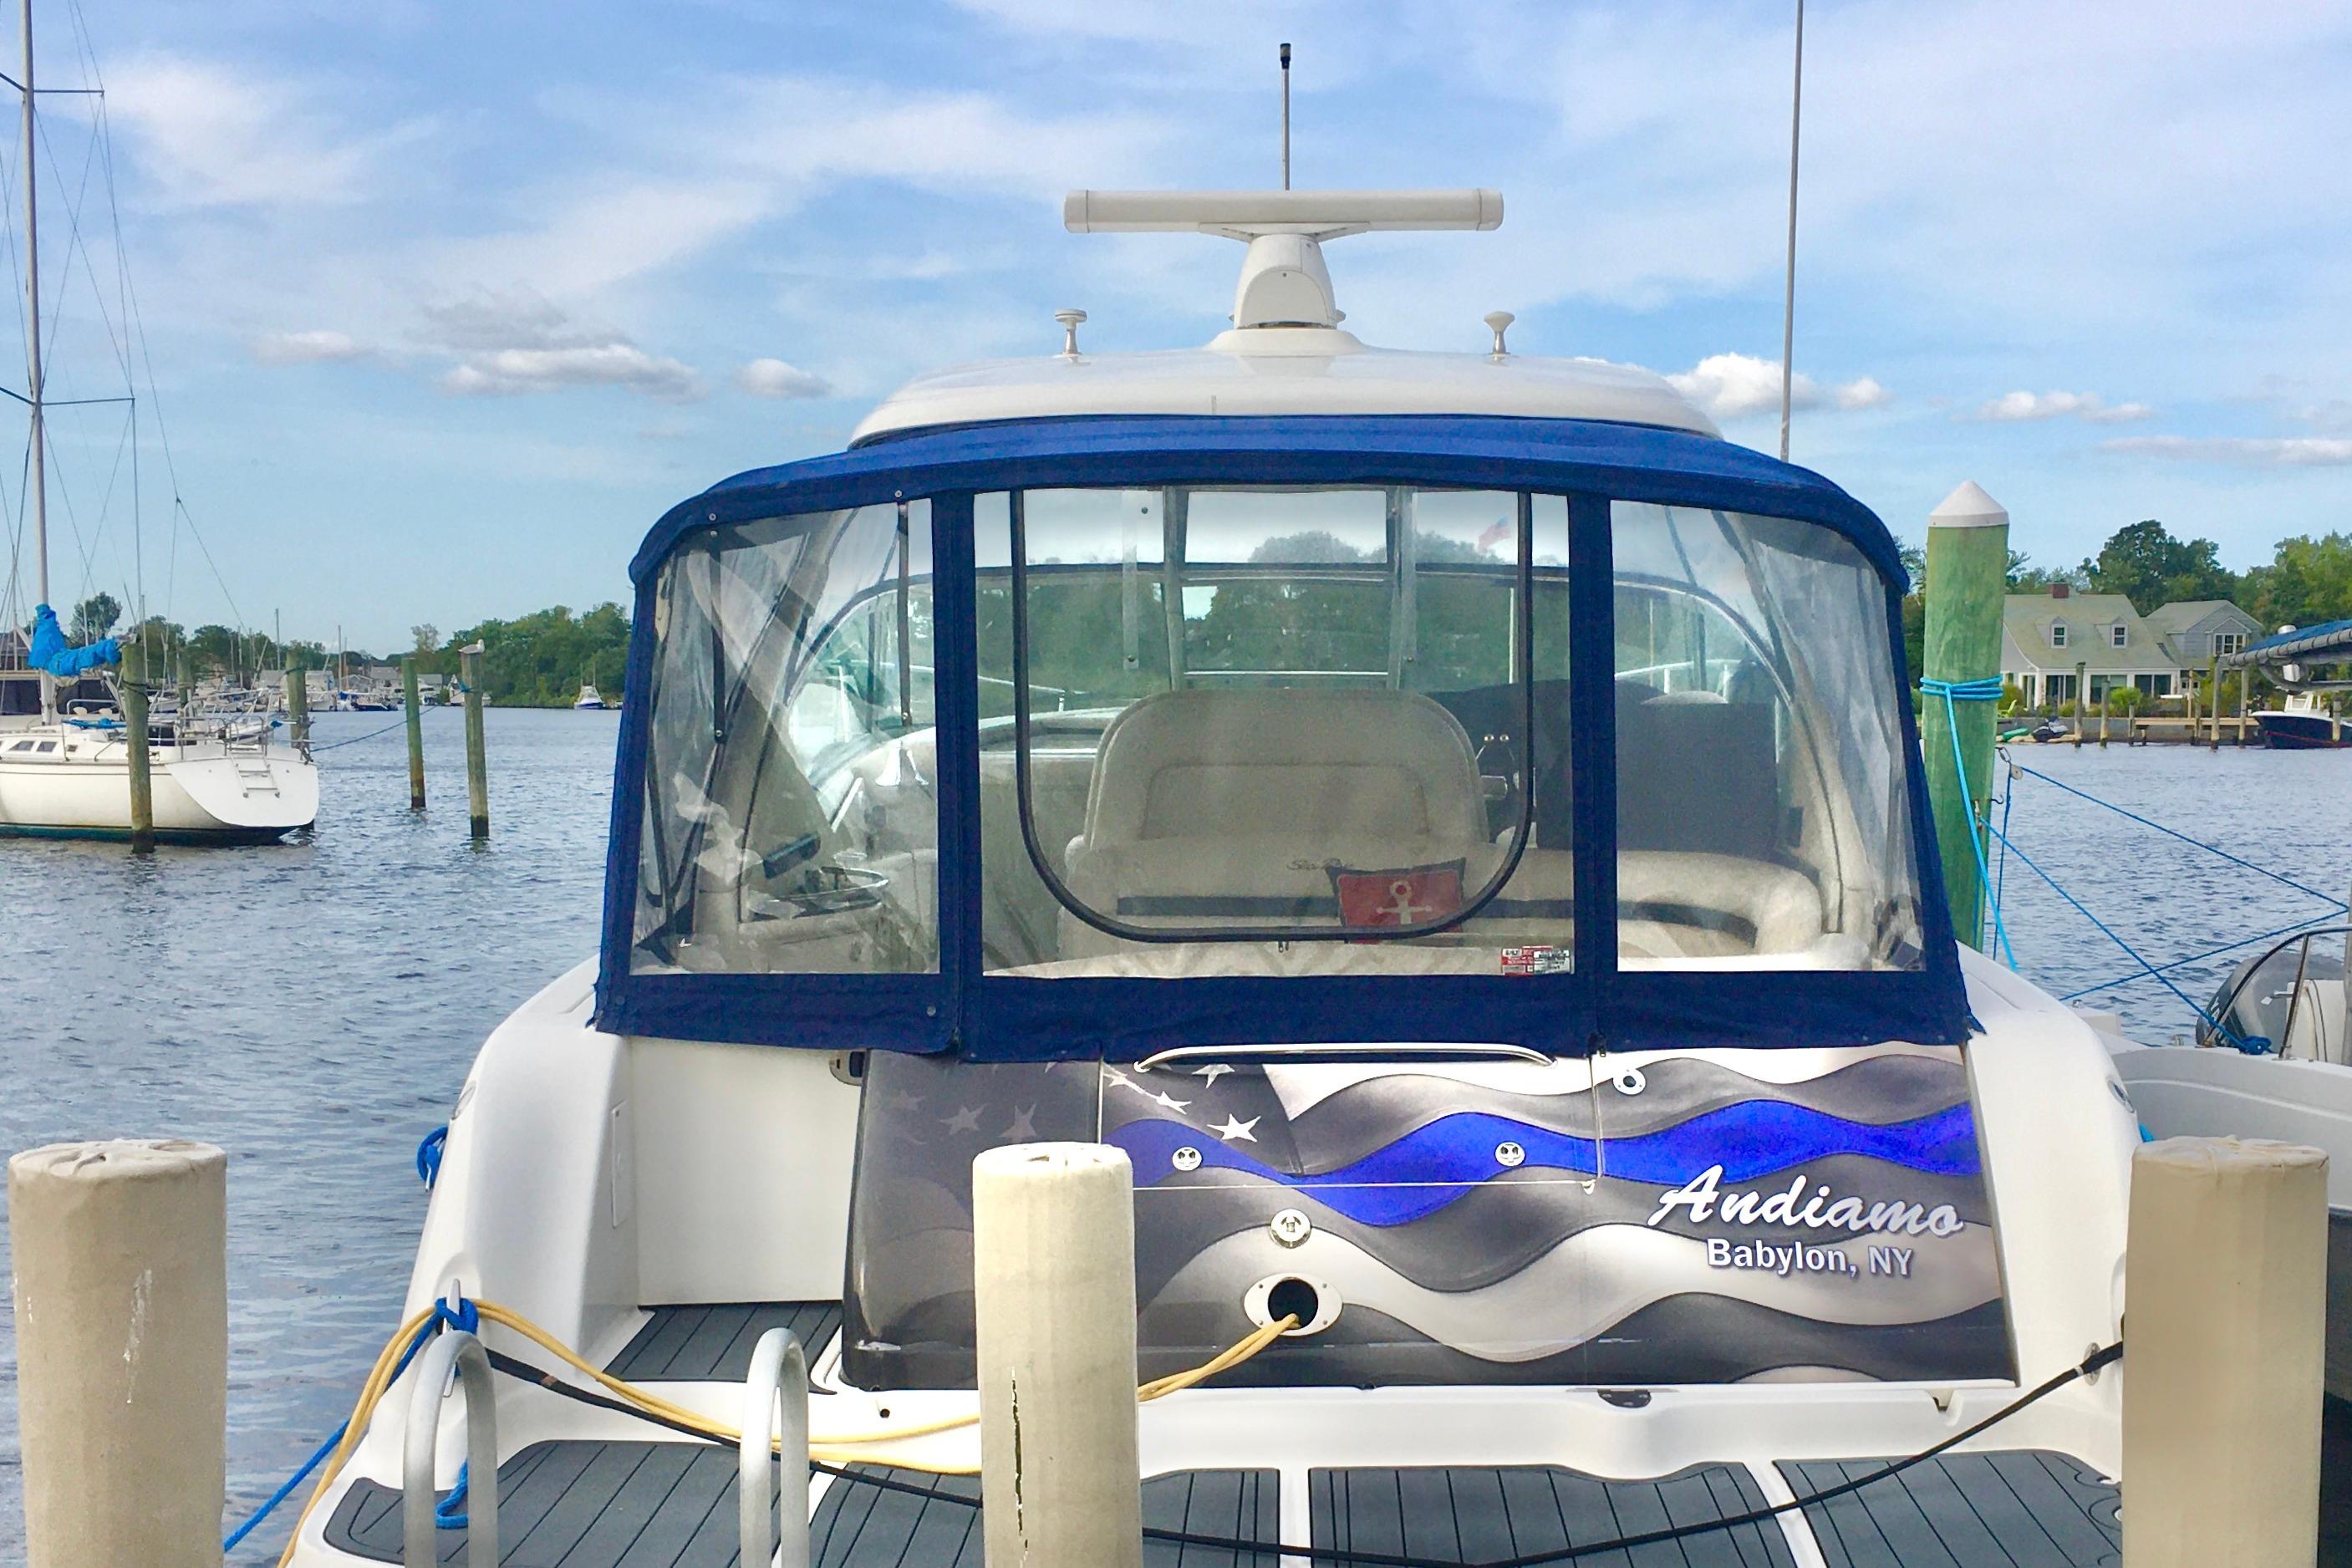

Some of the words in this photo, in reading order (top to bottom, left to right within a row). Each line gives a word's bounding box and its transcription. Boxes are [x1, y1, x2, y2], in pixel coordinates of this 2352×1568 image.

[1647, 1163, 1964, 1237] Andiamo
[1707, 1238, 1858, 1278] Babylon,
[1867, 1245, 1913, 1276] NY
